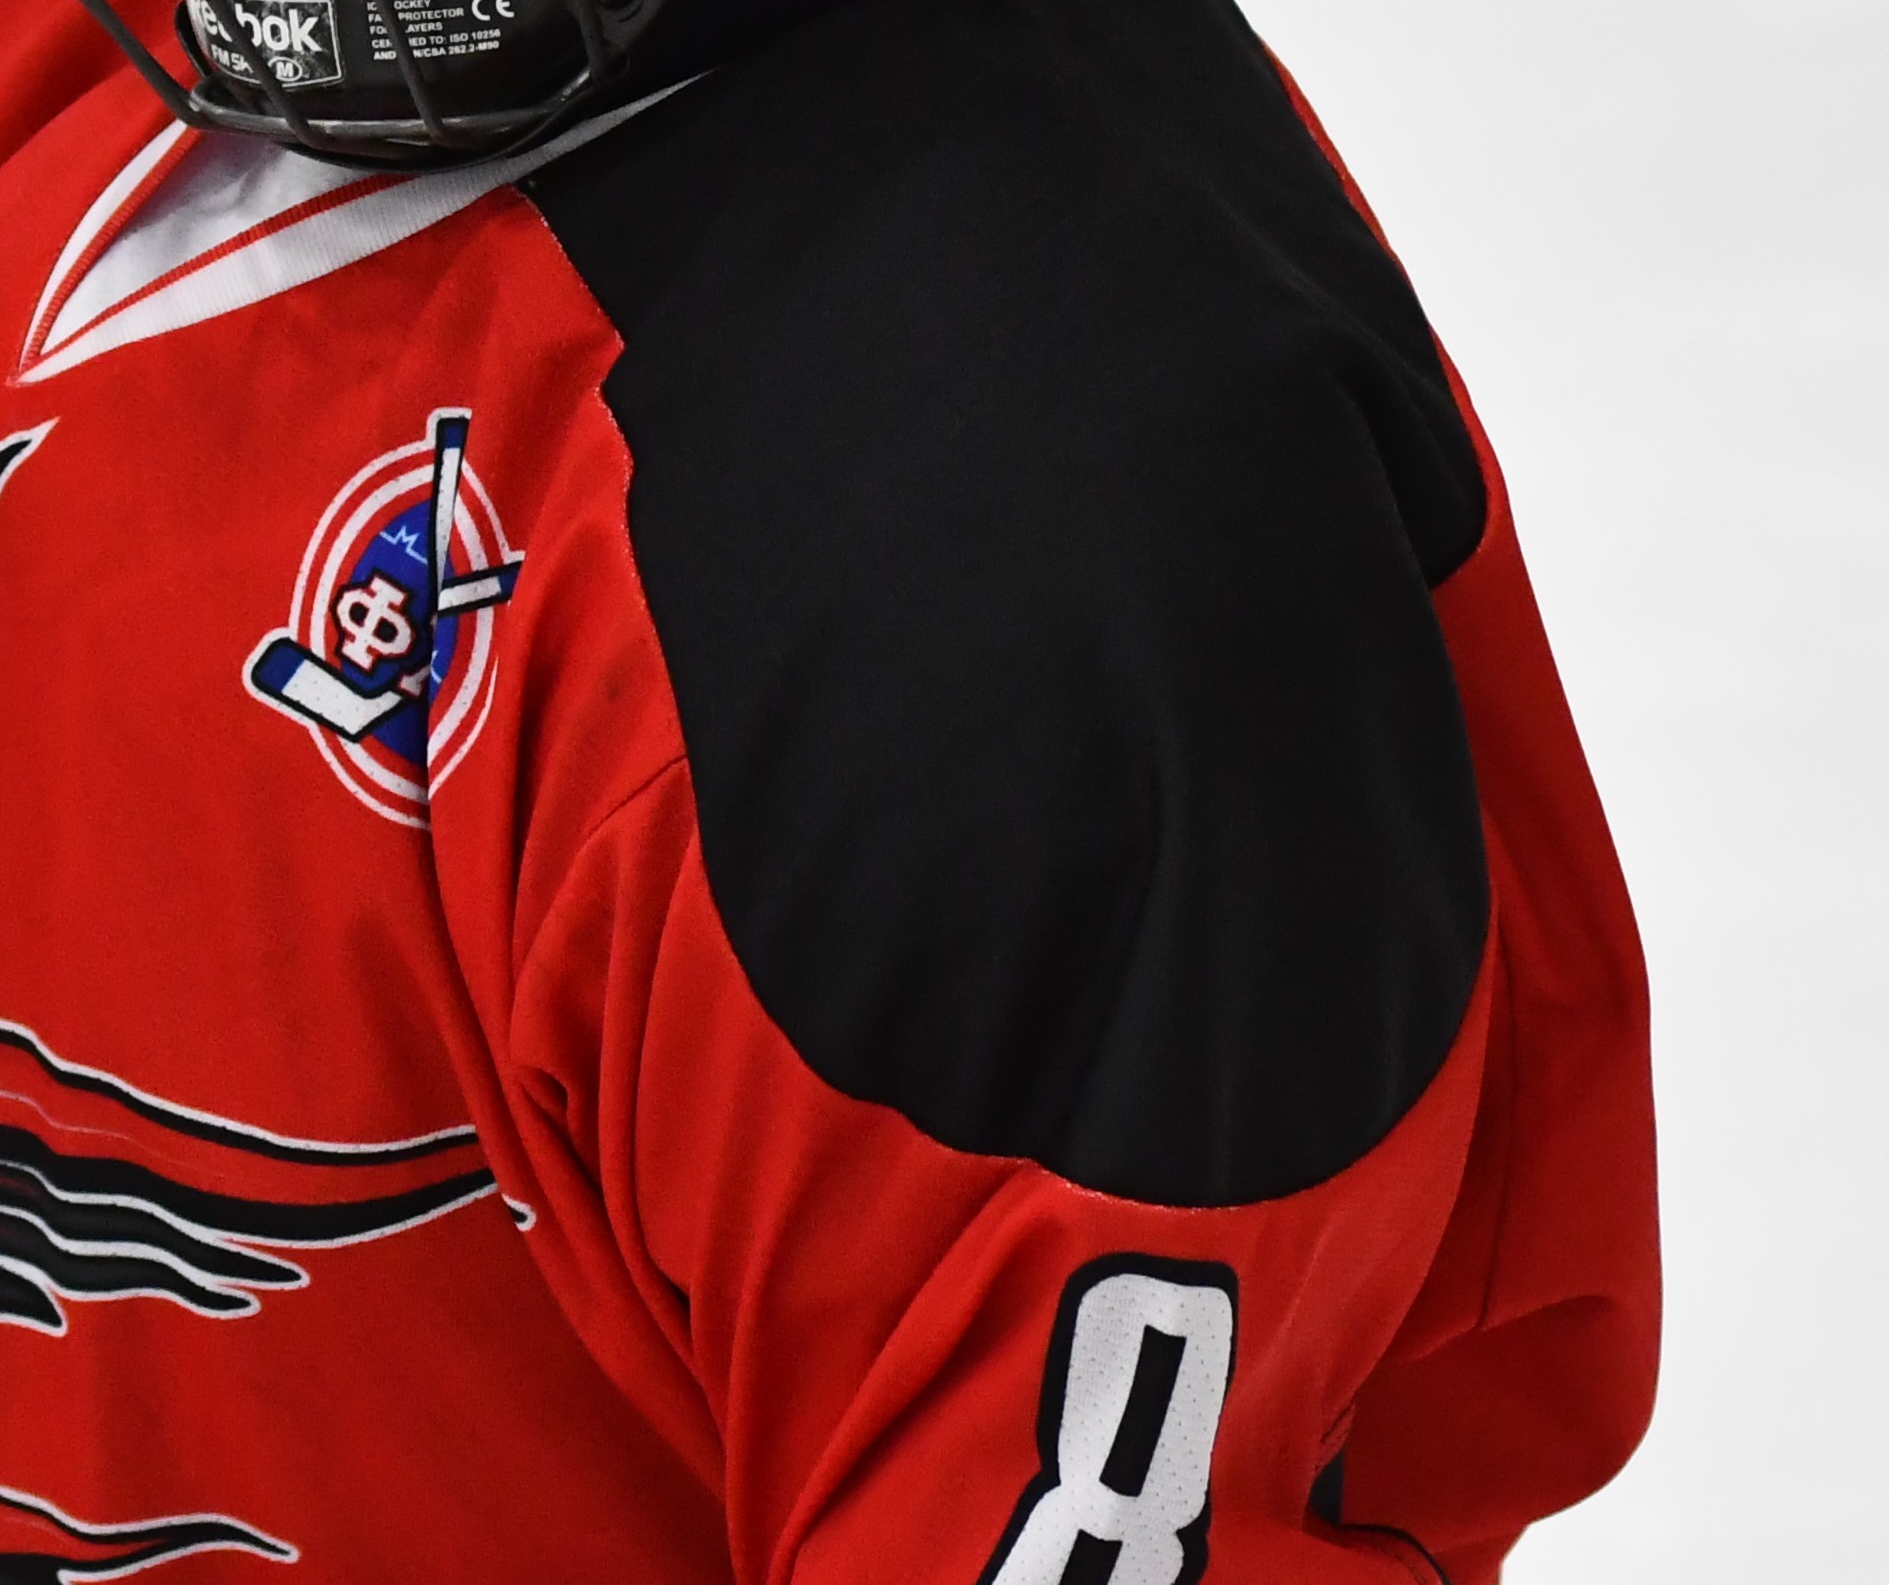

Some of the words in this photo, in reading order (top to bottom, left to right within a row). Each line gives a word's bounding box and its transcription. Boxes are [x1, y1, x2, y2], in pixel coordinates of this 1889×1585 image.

[397, 7, 465, 21] PROTECTOR
[373, 50, 397, 60] AND
[983, 1258, 1236, 1585] 8
